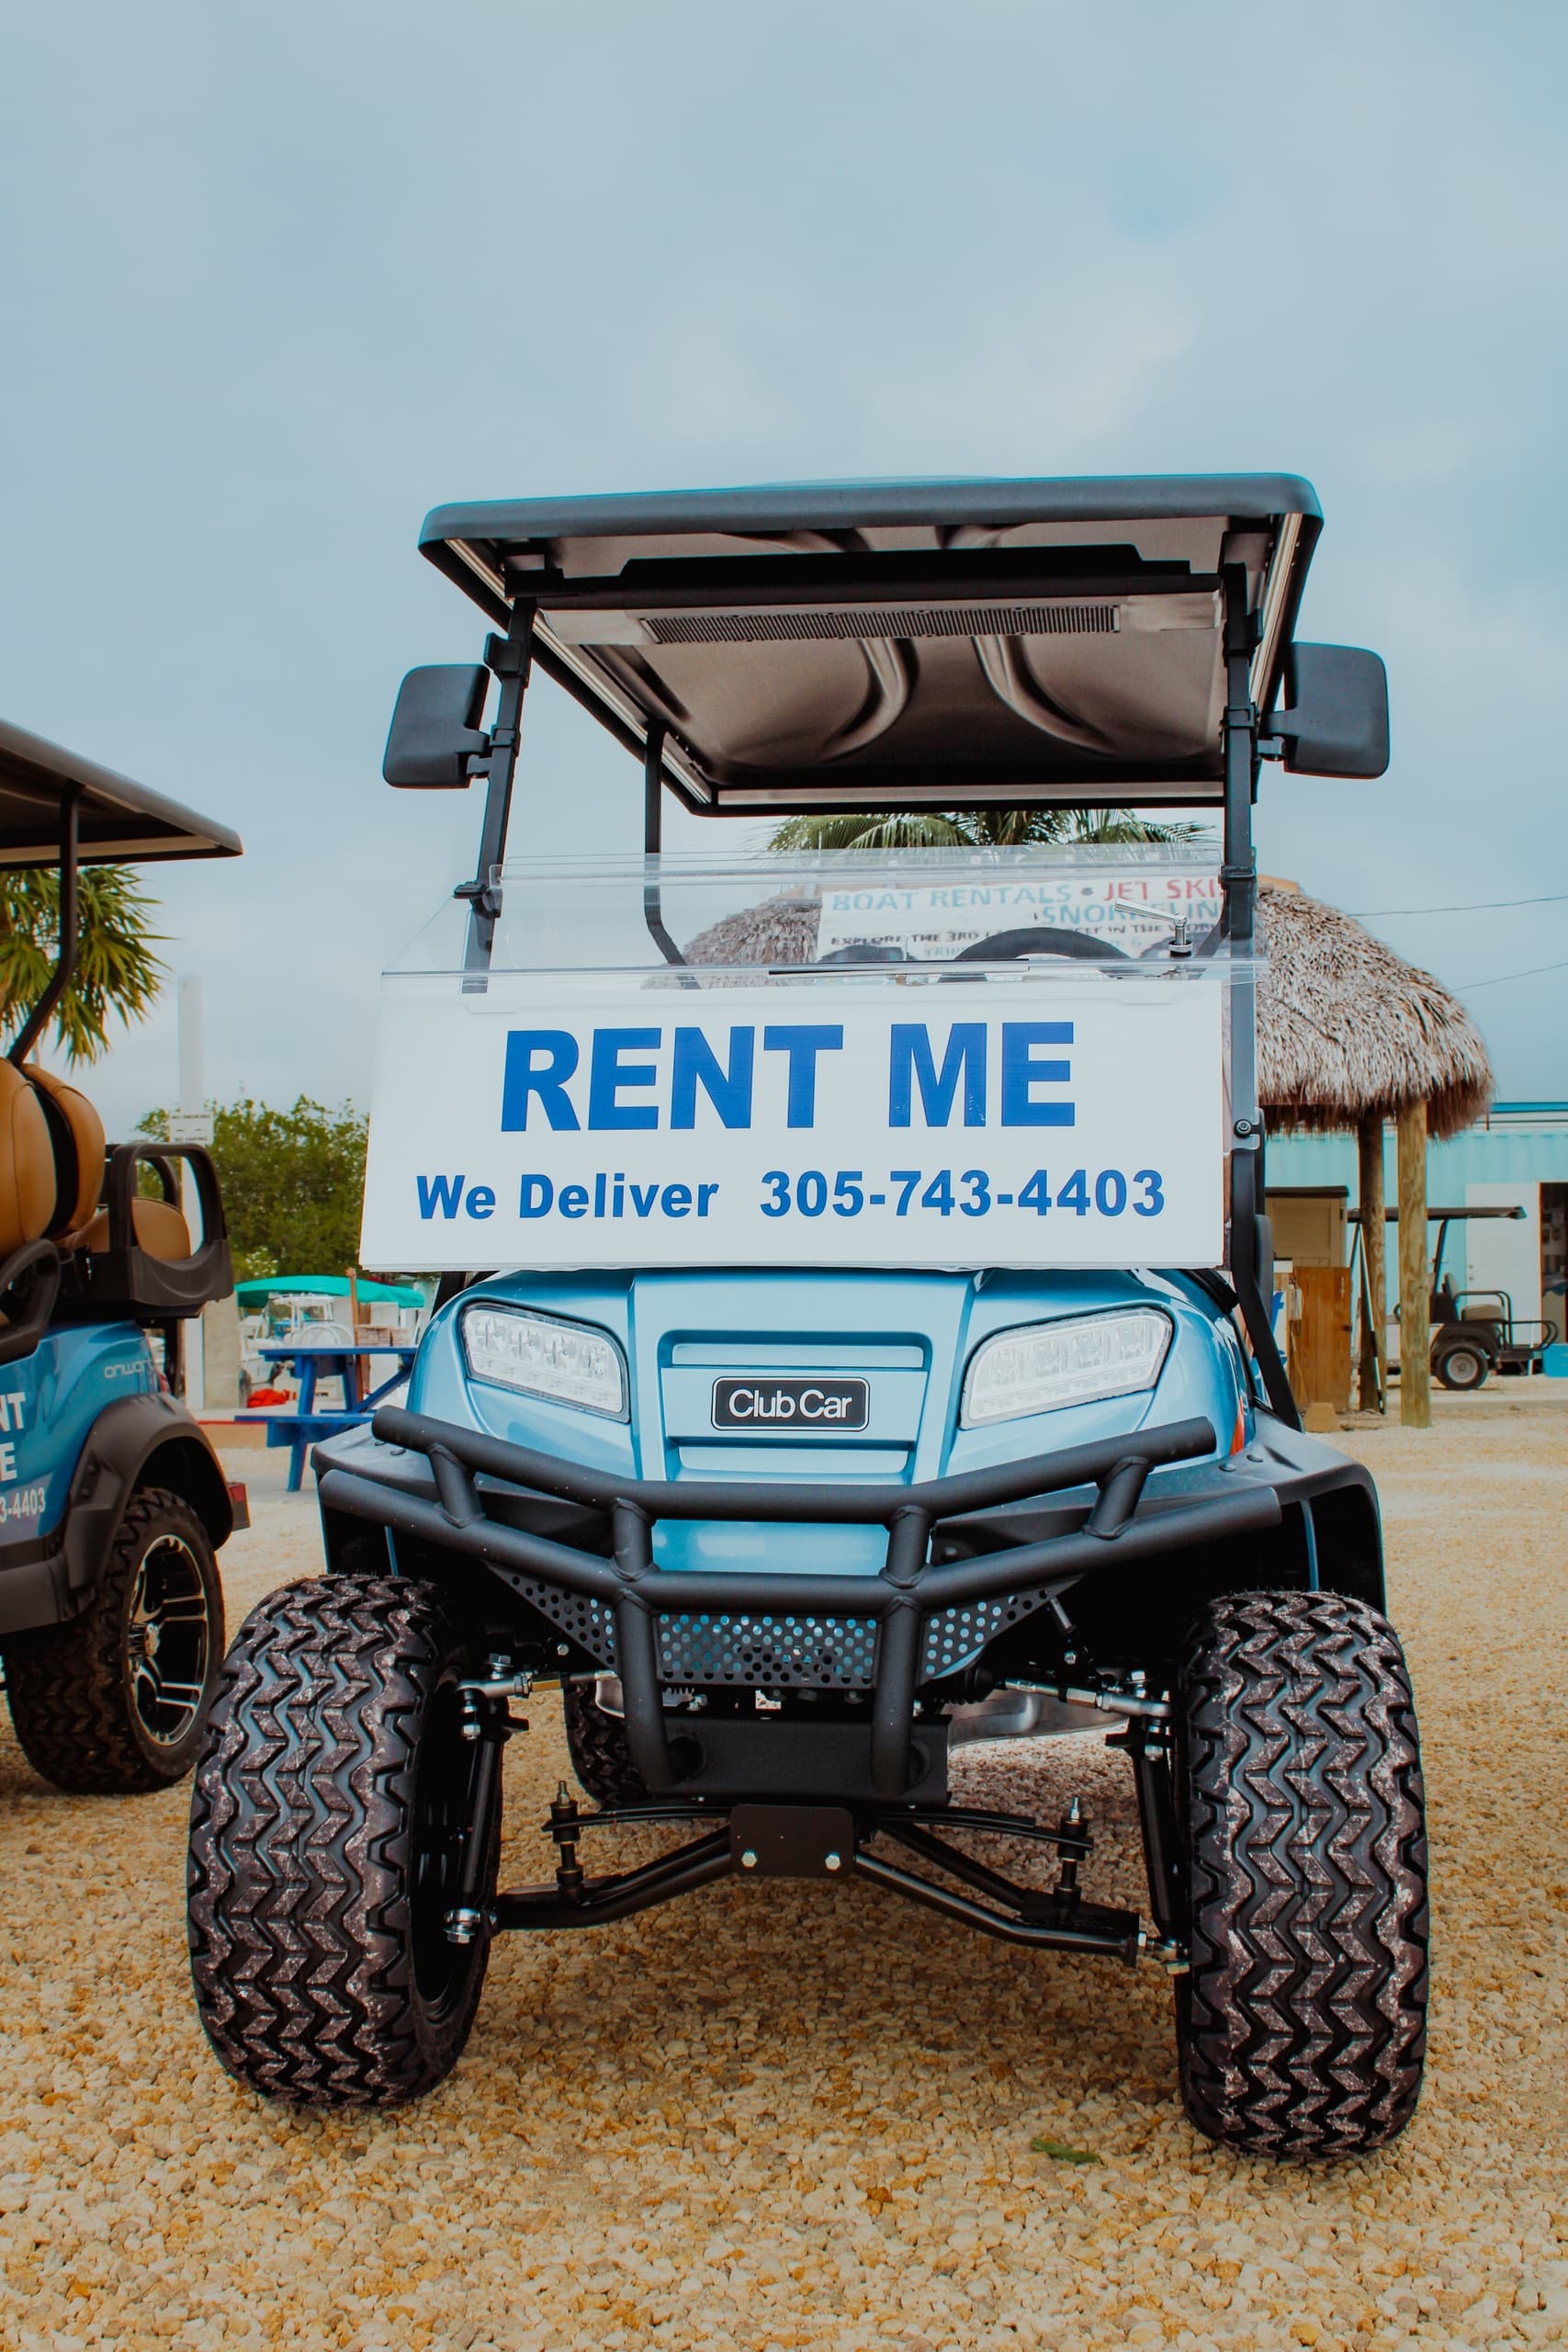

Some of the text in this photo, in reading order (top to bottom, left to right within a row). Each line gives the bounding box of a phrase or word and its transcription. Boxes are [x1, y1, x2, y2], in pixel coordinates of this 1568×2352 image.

[832, 876, 1224, 911] BOAT RENTALS JET SKI
[910, 933, 941, 943] THE
[501, 1022, 1076, 1132] RENT ME
[416, 1169, 1165, 1220] We Deliver 305-743-4403
[729, 1389, 852, 1418] Club Car
